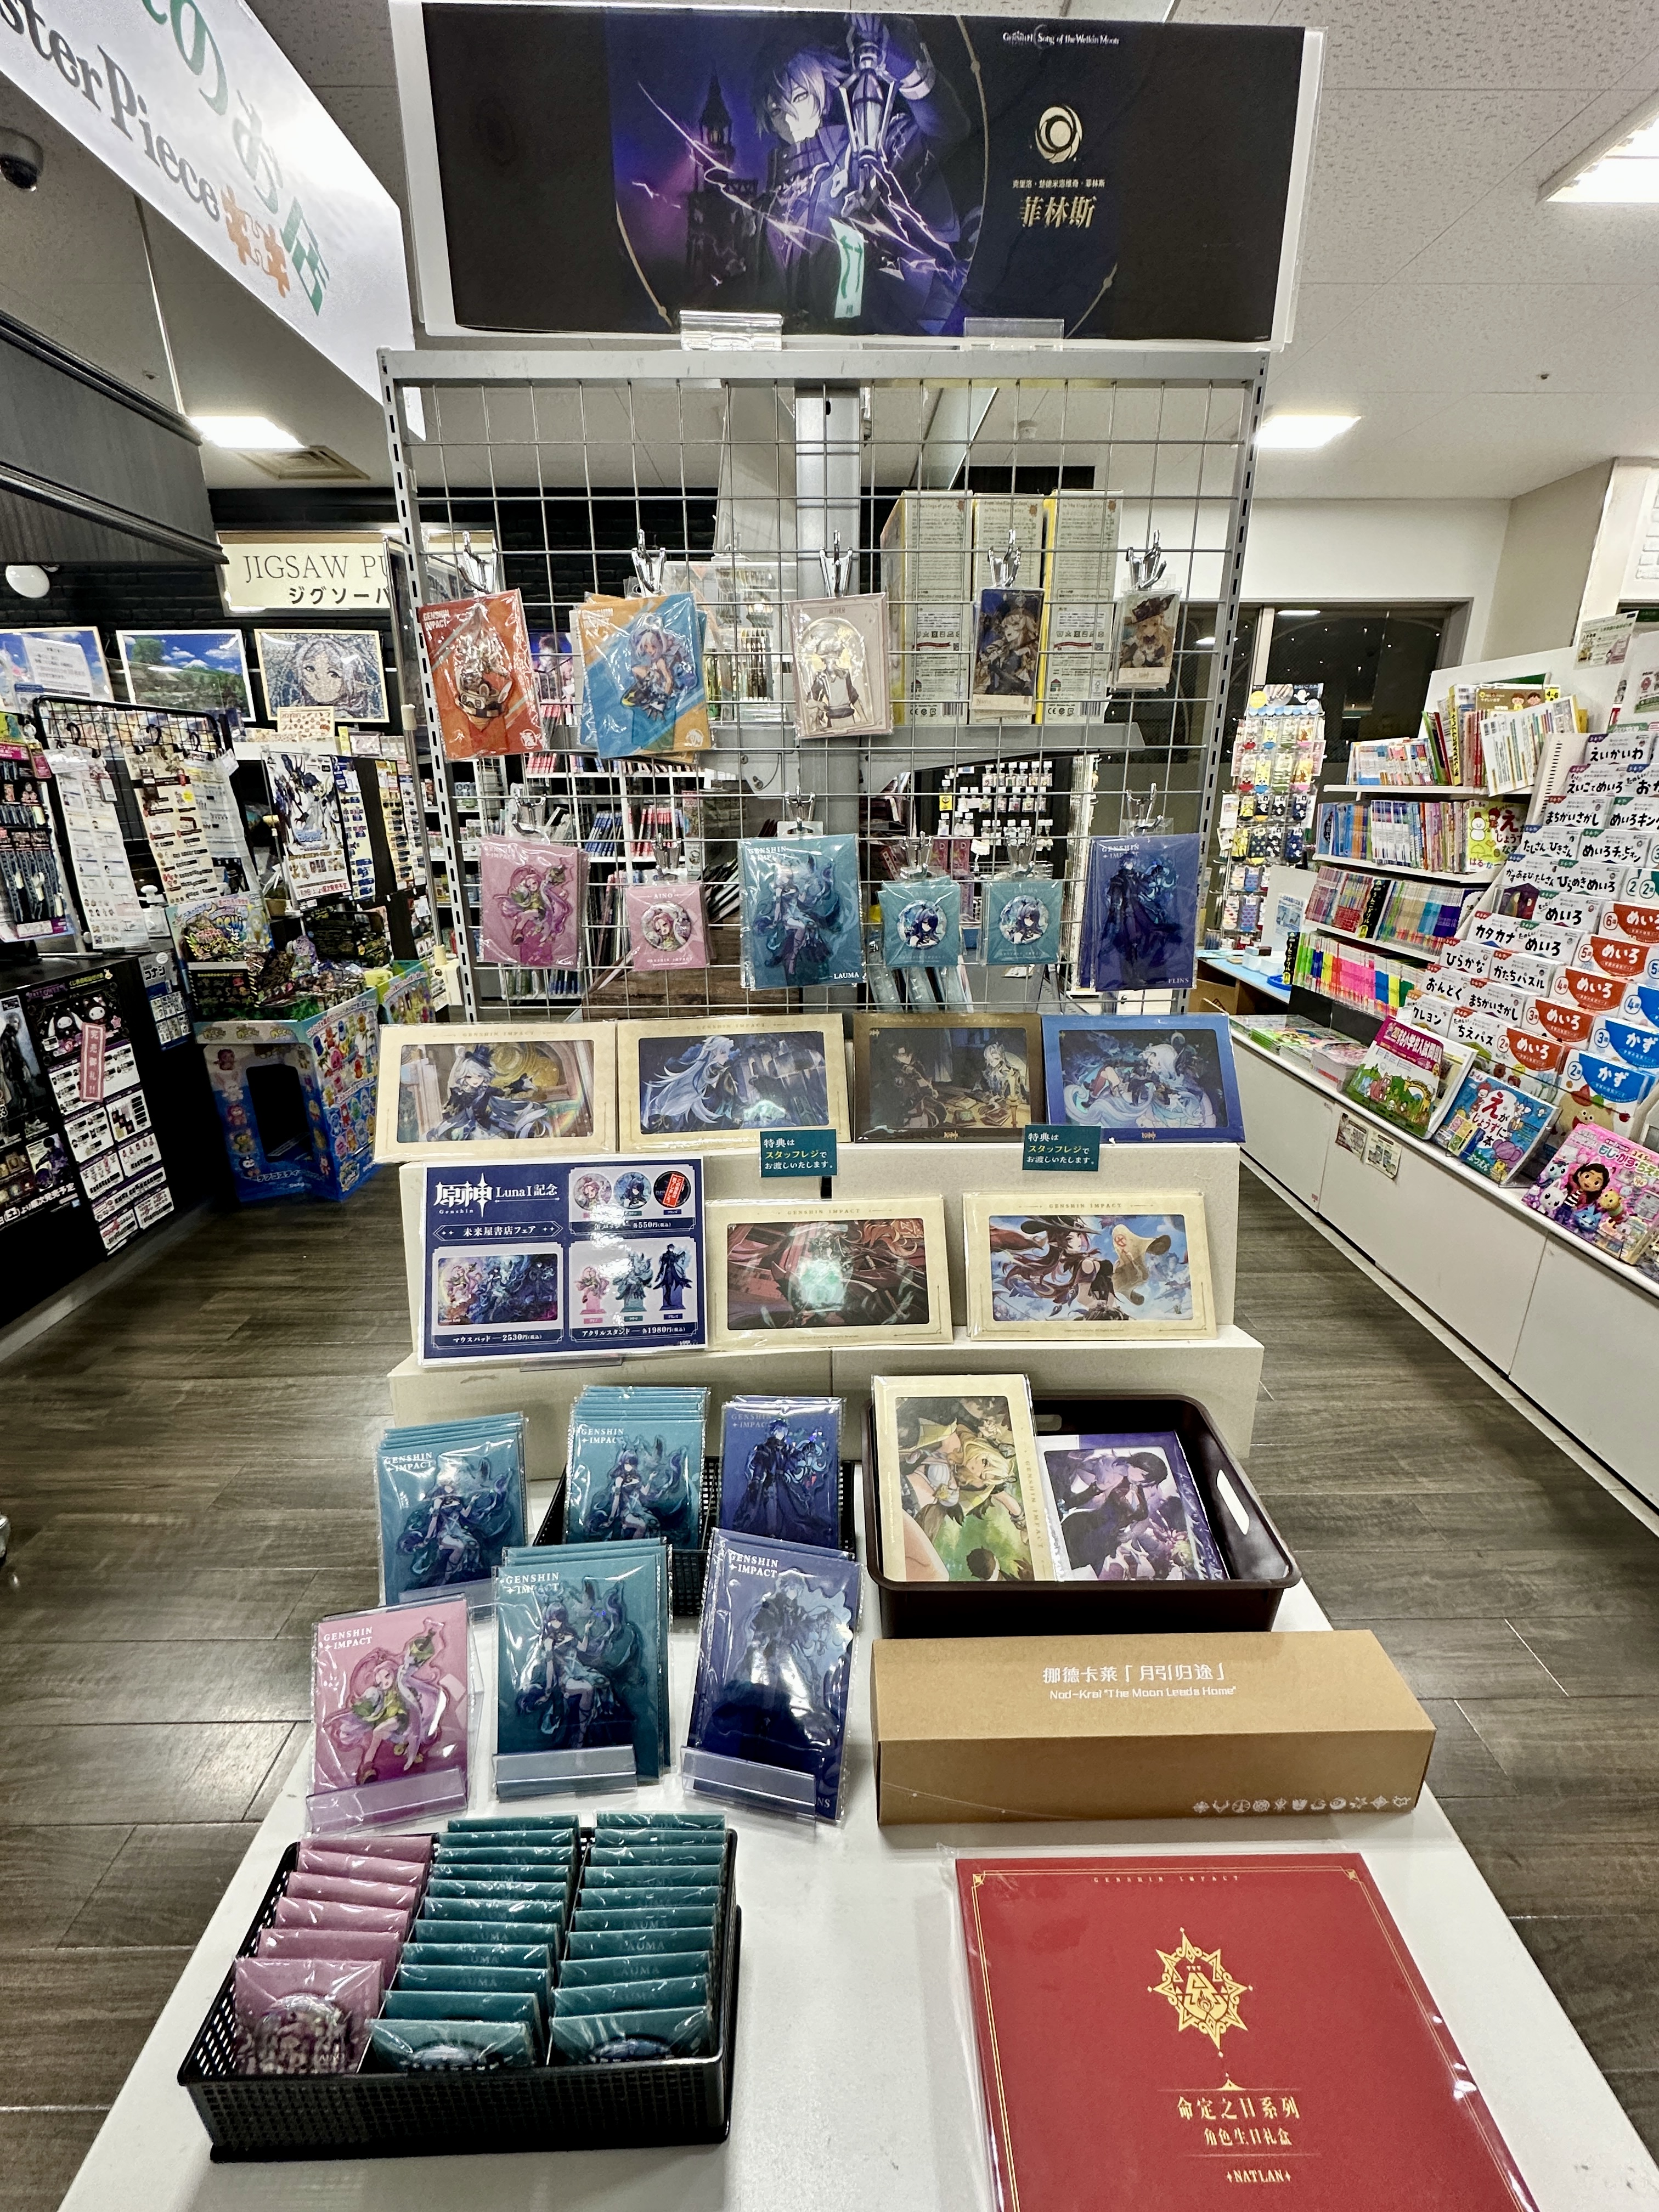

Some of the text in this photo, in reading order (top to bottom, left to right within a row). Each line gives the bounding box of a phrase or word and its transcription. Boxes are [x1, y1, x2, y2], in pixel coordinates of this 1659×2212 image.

[1018, 195, 1097, 228] 菲林斯
[243, 555, 349, 583] JIGSAW
[1590, 747, 1644, 761] えいかいわ
[1500, 809, 1519, 832] え
[1545, 811, 1599, 826] まちがいさがし
[1545, 907, 1583, 926] めいろ
[1475, 924, 1516, 944] カタカナ
[1525, 938, 1561, 957] めいろ
[1601, 943, 1640, 964] めいろ
[833, 971, 860, 980] LAUMA
[1576, 977, 1613, 998] めいろ
[1413, 1007, 1442, 1025] クレヨン
[1469, 994, 1518, 1022] まちがいさがし
[1547, 1008, 1581, 1031] めいろ
[1516, 1037, 1550, 1060] めいろ
[1626, 1031, 1658, 1054] かず
[1597, 1066, 1629, 1088] かず
[1481, 1091, 1504, 1119] え
[763, 1138, 795, 1148] 特典は
[1028, 1132, 1059, 1142] 特典は
[765, 1149, 827, 1160] スタッフレジで
[1028, 1144, 1090, 1154] スタッフレジで
[764, 1160, 834, 1170] お渡しいたします。
[1026, 1155, 1094, 1165] お渡しいたします。
[433, 1172, 493, 1218] 原神
[463, 1226, 537, 1237] 未来屋書店フェア
[582, 1325, 686, 1336] アクリルスタンド 各1980円(税込)
[383, 1452, 433, 1464] GENSHIN
[395, 1460, 432, 1471] IMPACT
[1024, 1460, 1043, 1549] GENSHIN IMPACT
[730, 1552, 779, 1568] GENSHIN
[506, 1571, 560, 1584] GENSHIN
[737, 1563, 778, 1578] IMPACT
[323, 1626, 373, 1642] GENSHIN
[334, 1635, 373, 1650] IMPACT
[1042, 1662, 1225, 1684] 挪德卡莱「月引归途」
[1132, 1686, 1164, 1698] Moon
[1166, 1686, 1200, 1697] Leads
[1177, 2096, 1300, 2120] 命定之日系列
[1233, 2169, 1285, 2183] NATLAN
